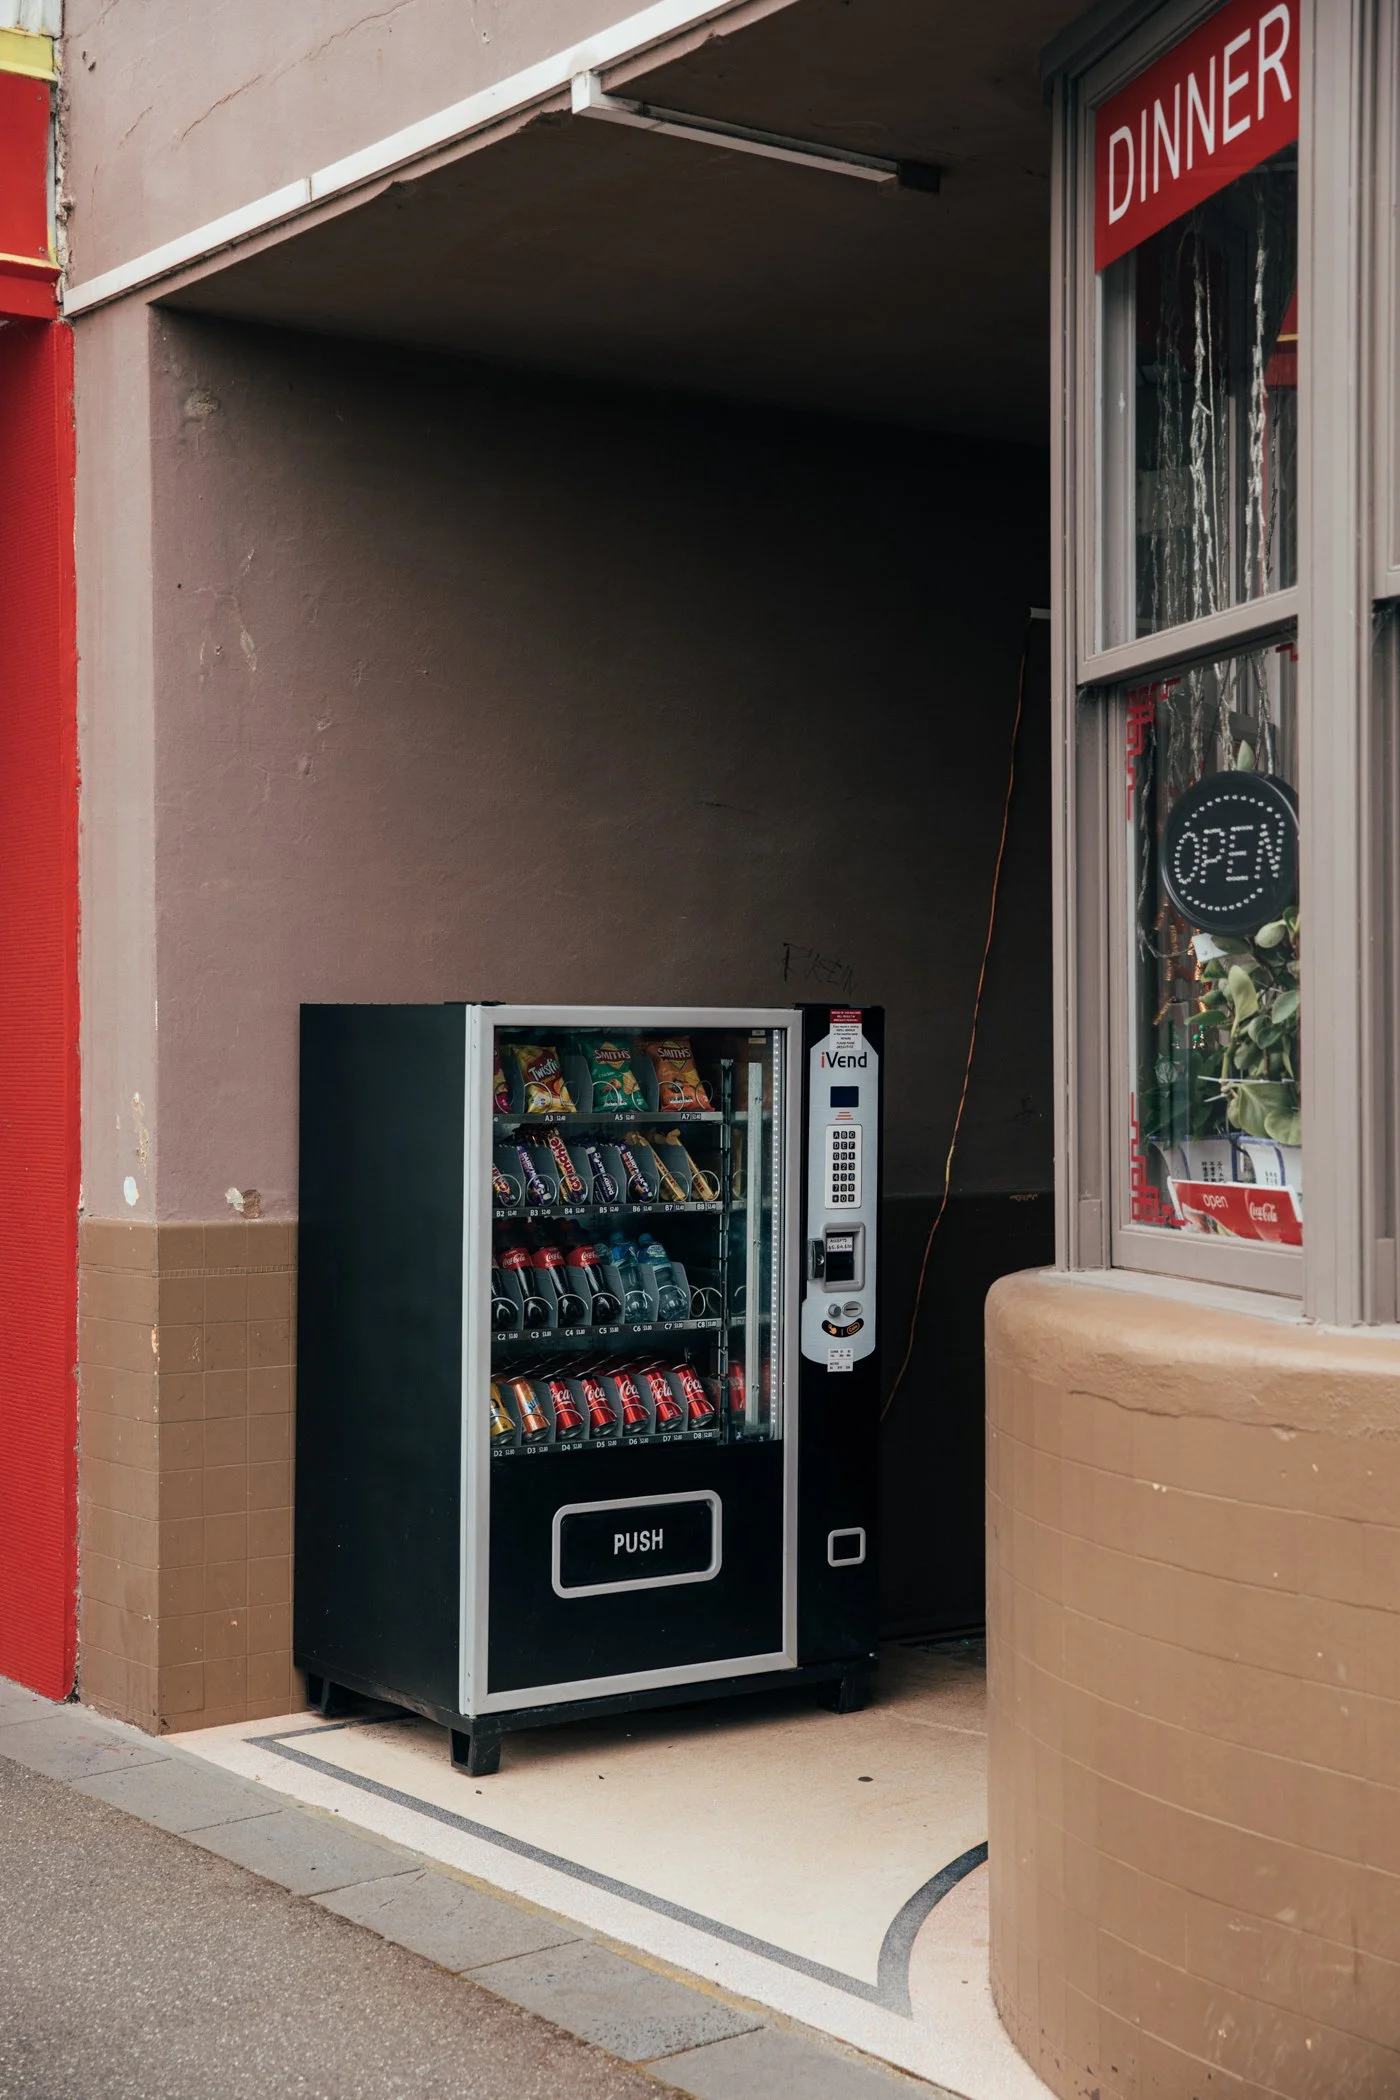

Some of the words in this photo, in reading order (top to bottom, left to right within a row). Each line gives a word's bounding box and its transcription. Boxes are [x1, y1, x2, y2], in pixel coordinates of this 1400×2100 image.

[1108, 3, 1292, 226] DINNER
[1174, 823, 1285, 885] OPEN
[595, 1048, 631, 1061] SMITH'S
[657, 1047, 691, 1060] SMITH'S
[821, 1051, 868, 1068] iVend
[1202, 1194, 1229, 1210] open
[613, 1528, 663, 1555] PUSH
